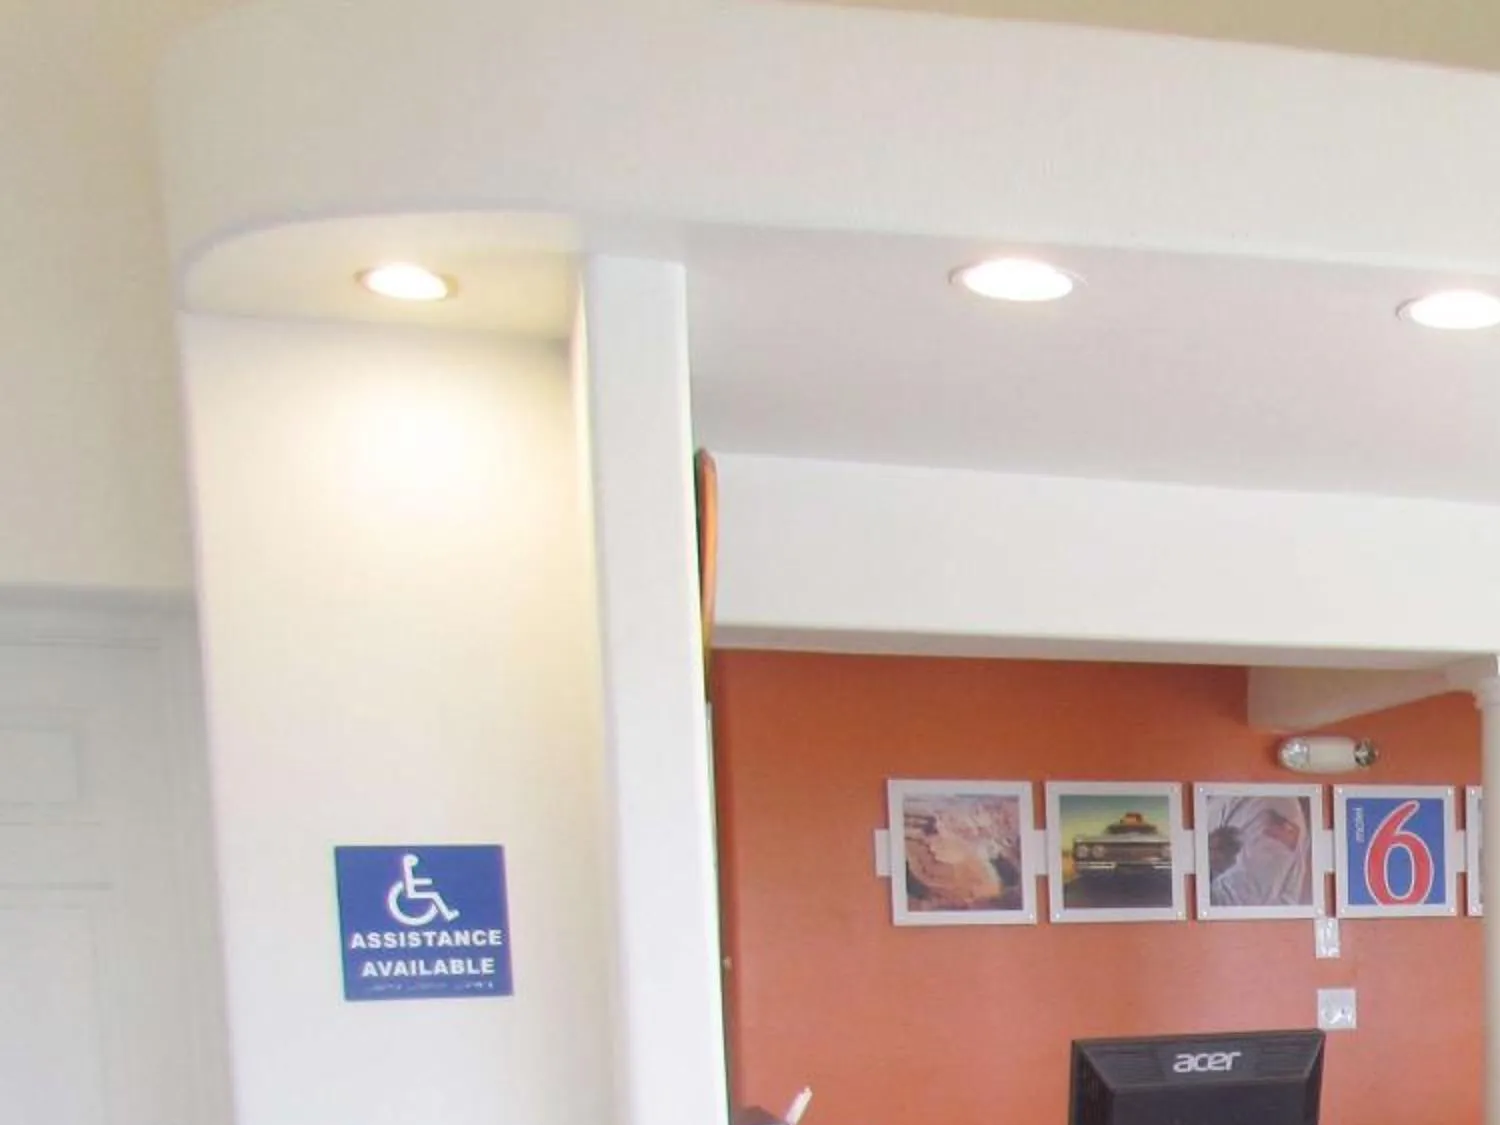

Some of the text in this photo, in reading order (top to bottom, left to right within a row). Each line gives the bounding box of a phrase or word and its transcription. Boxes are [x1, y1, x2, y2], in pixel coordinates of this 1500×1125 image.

[1364, 800, 1435, 905] 6
[351, 929, 503, 949] ASSISTANCE
[361, 957, 496, 977] AVAILABLE
[1173, 1051, 1241, 1073] acer
